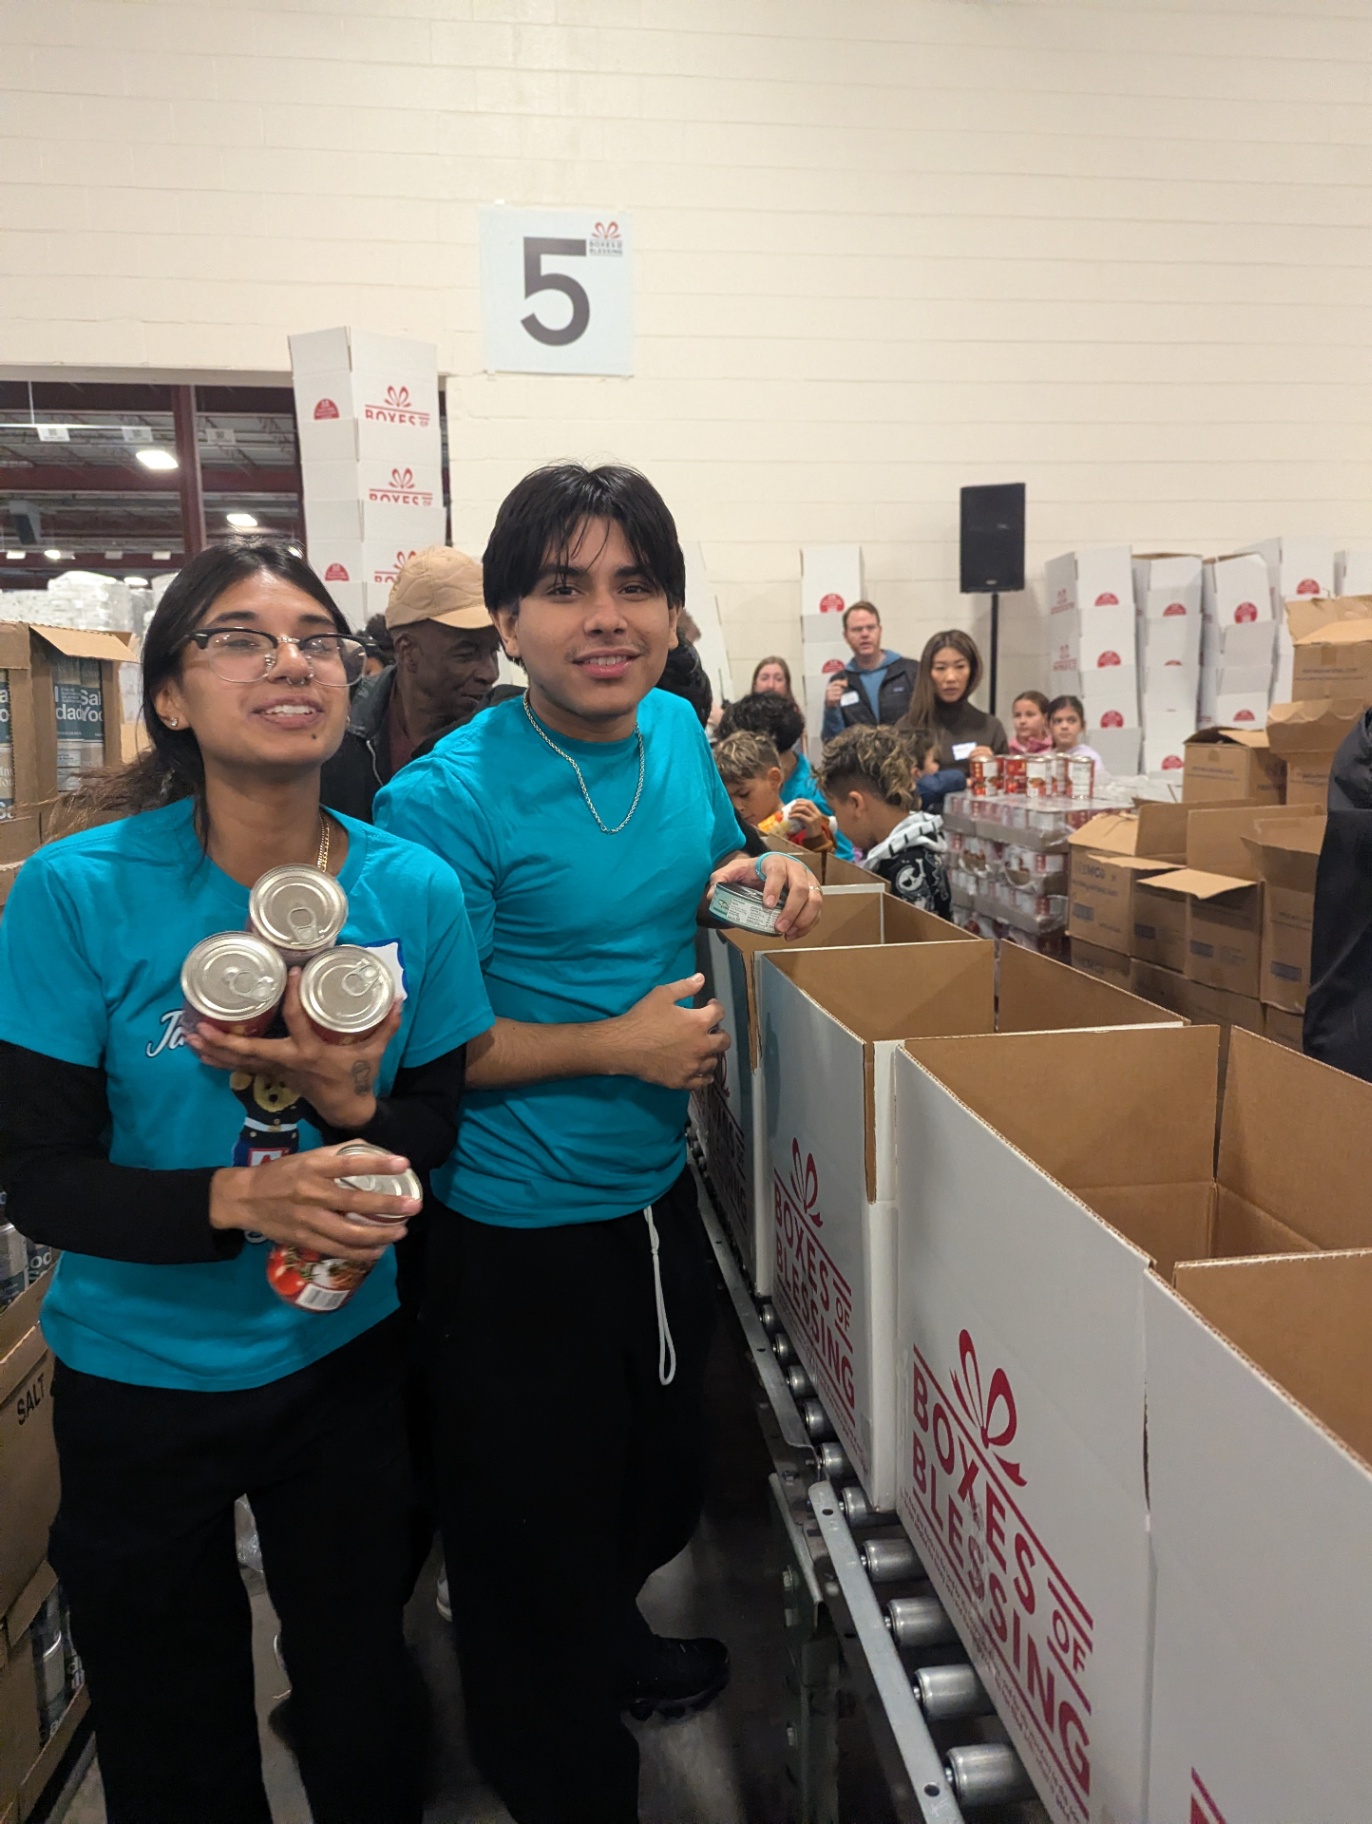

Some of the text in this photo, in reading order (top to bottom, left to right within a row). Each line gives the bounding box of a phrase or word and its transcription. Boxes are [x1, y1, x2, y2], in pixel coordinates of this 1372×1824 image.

[521, 237, 590, 346] 5
[773, 1180, 850, 1332] BOXES OF
[774, 1229, 856, 1411] BLESSING
[17, 1372, 45, 1426] SALT
[912, 1360, 1037, 1616] BOXES
[1050, 1608, 1086, 1674] OF
[911, 1430, 1091, 1797] BLESSING
